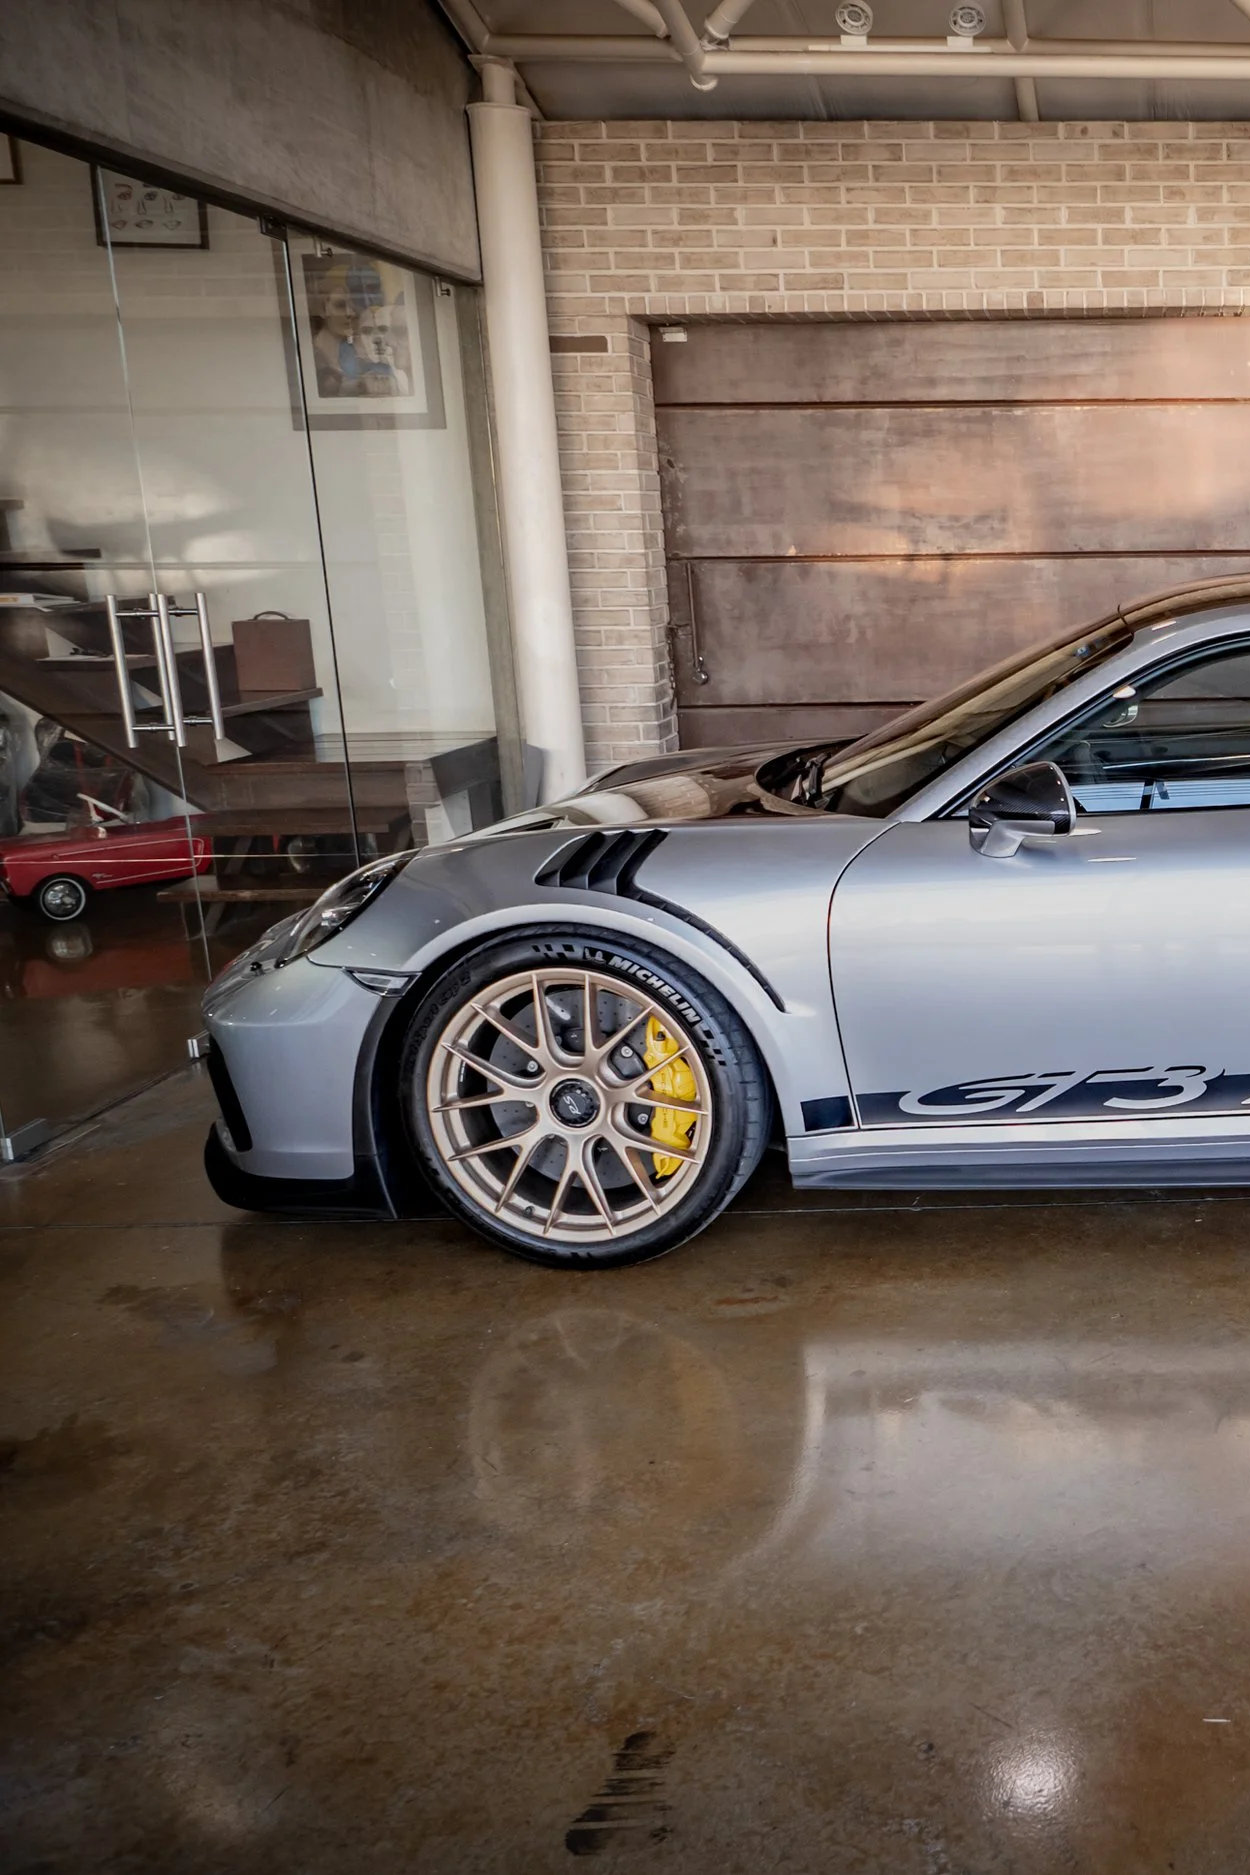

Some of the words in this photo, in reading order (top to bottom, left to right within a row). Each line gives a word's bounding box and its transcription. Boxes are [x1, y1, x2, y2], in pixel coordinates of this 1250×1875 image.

[608, 955, 702, 1023] MICHELIN
[562, 1095, 582, 1115] RS
[898, 1065, 1226, 1116] GT3
